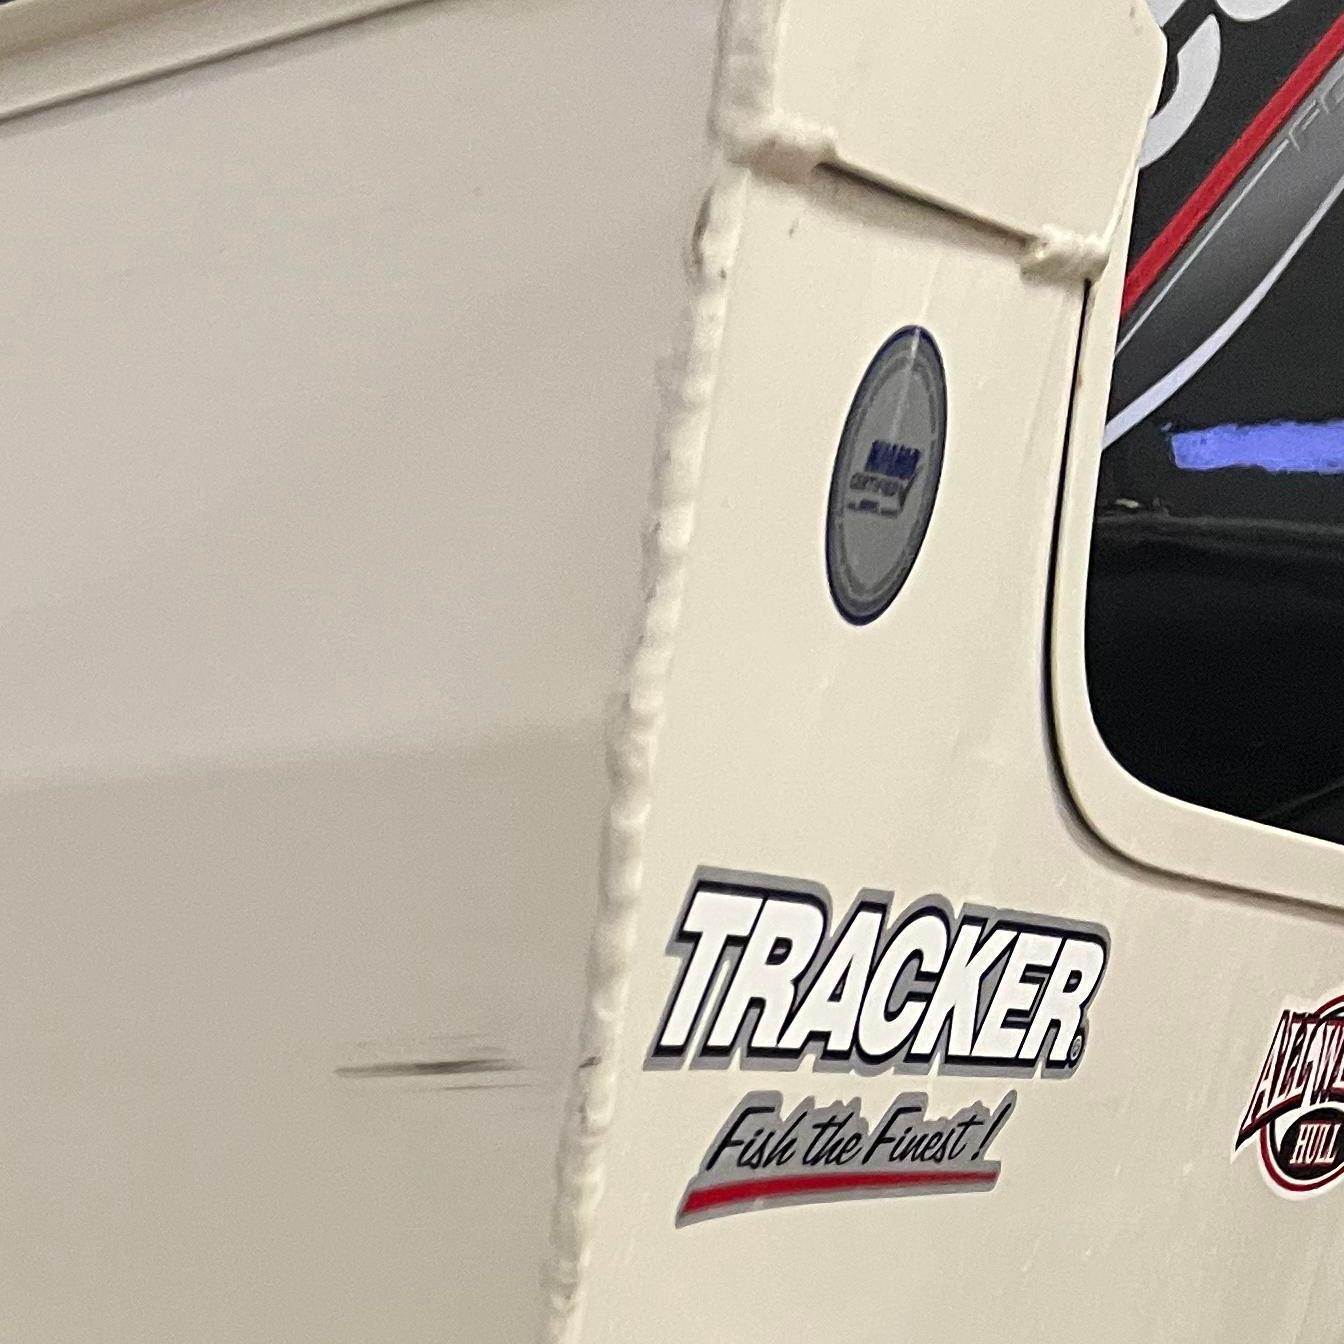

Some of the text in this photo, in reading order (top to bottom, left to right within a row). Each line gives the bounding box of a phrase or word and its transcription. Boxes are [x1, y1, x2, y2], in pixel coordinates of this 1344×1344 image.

[652, 879, 1110, 1068] TRACKER
[706, 1106, 808, 1170] Fish
[801, 1111, 863, 1166] the
[1289, 1122, 1342, 1165] HULL
